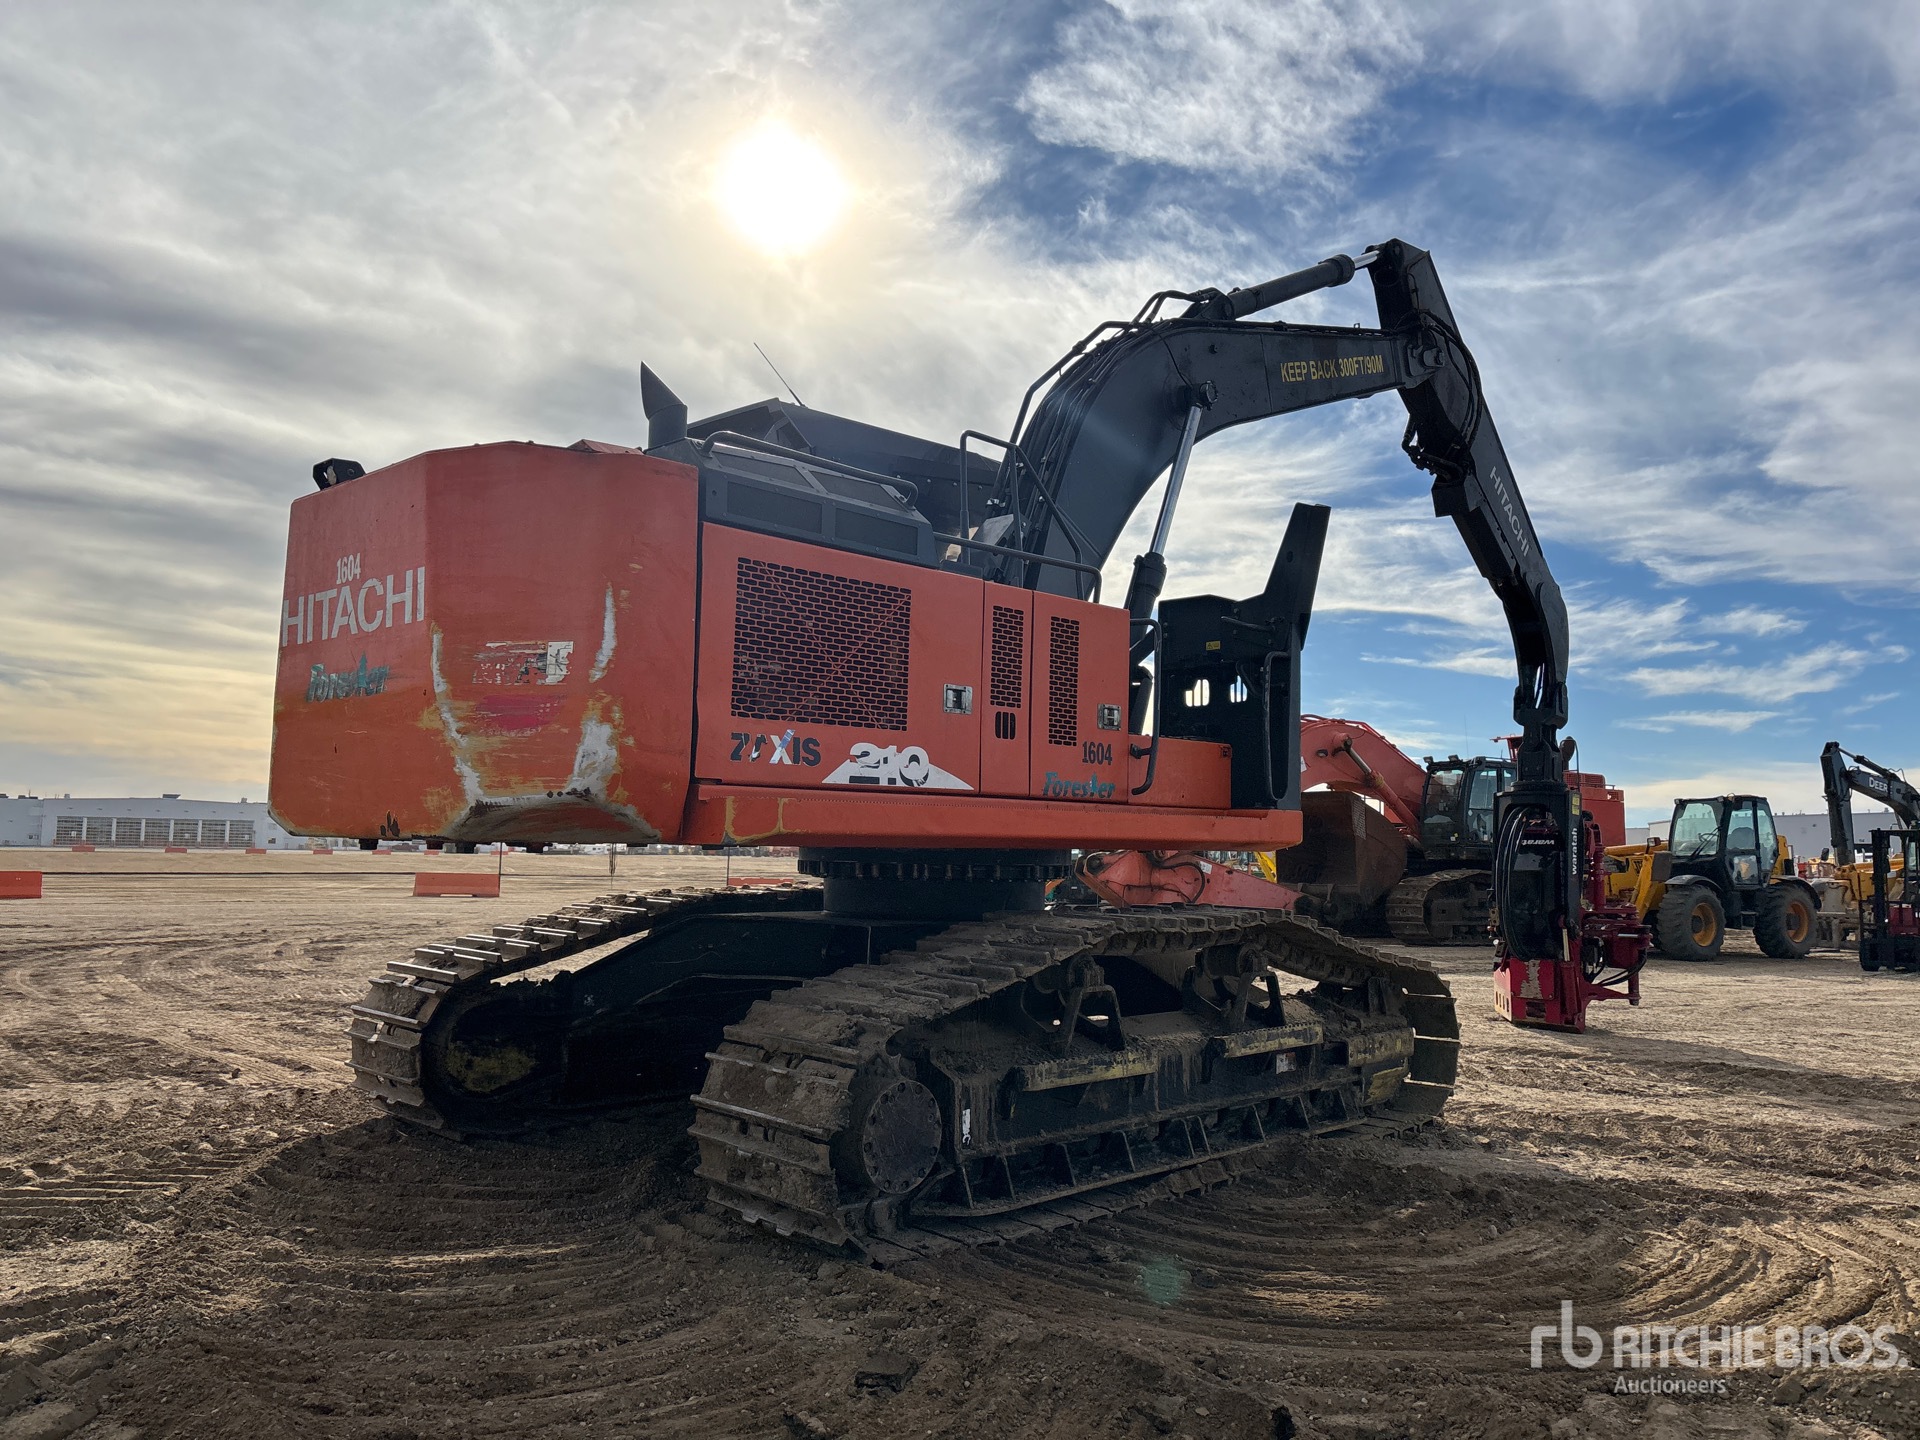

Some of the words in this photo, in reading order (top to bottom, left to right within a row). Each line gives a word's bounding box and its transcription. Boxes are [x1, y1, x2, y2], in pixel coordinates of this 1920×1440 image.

[1280, 361, 1308, 382] KEEP
[1309, 359, 1338, 380] BACK
[1338, 354, 1384, 377] 300FT/90M
[1490, 466, 1529, 557] HITACHI
[336, 553, 361, 584] 1604
[281, 566, 426, 648] HITACHI
[850, 742, 930, 788] 210
[1082, 741, 1113, 766] 1604
[1042, 771, 1116, 798] Forester
[1869, 777, 1893, 795] DEER
